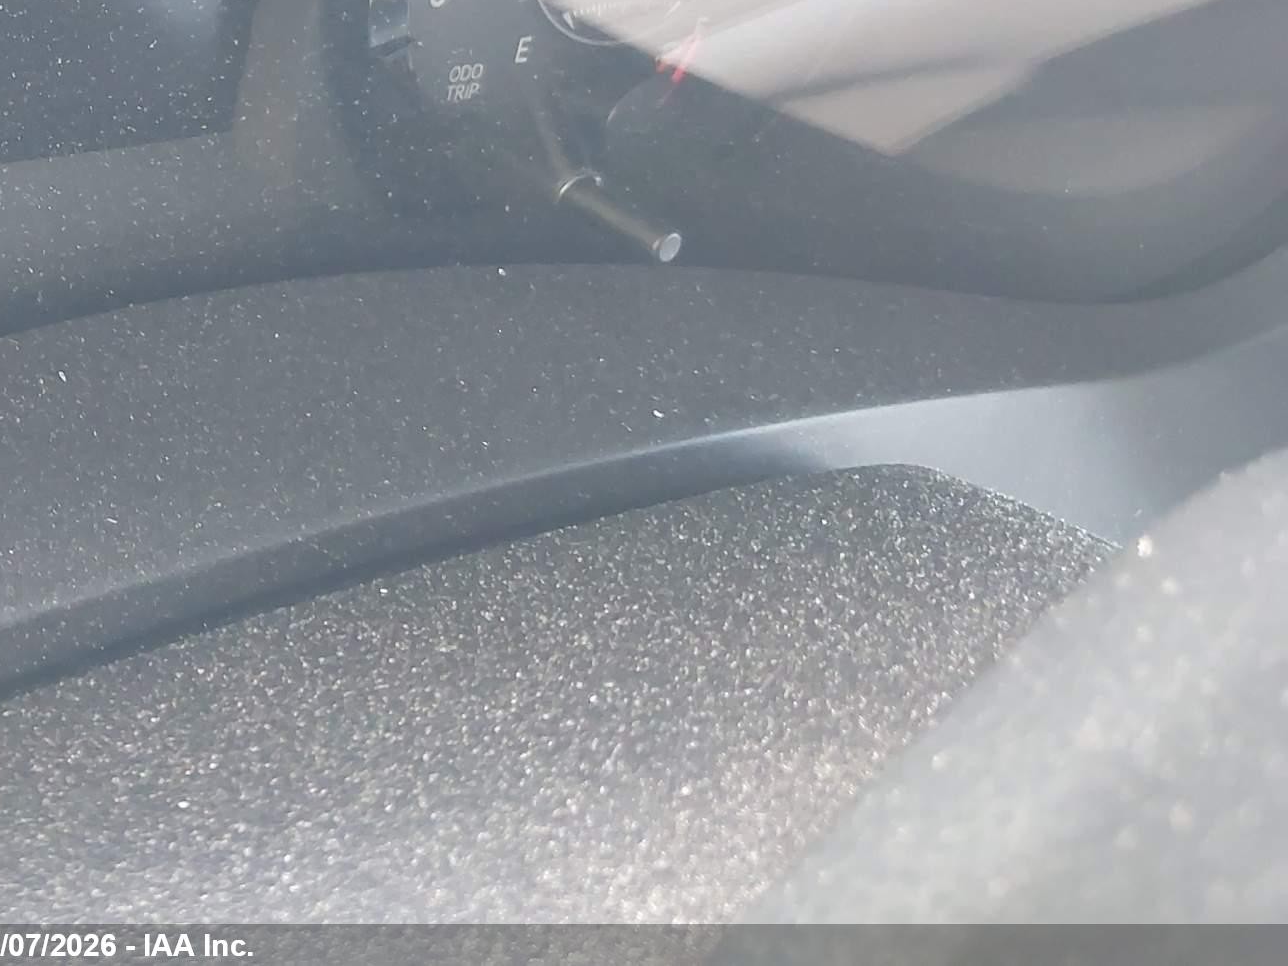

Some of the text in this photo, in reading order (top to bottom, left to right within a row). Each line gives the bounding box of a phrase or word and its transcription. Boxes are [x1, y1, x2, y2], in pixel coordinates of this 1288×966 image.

[514, 35, 534, 65] E
[448, 62, 484, 83] ODO
[446, 83, 482, 104] TRIP
